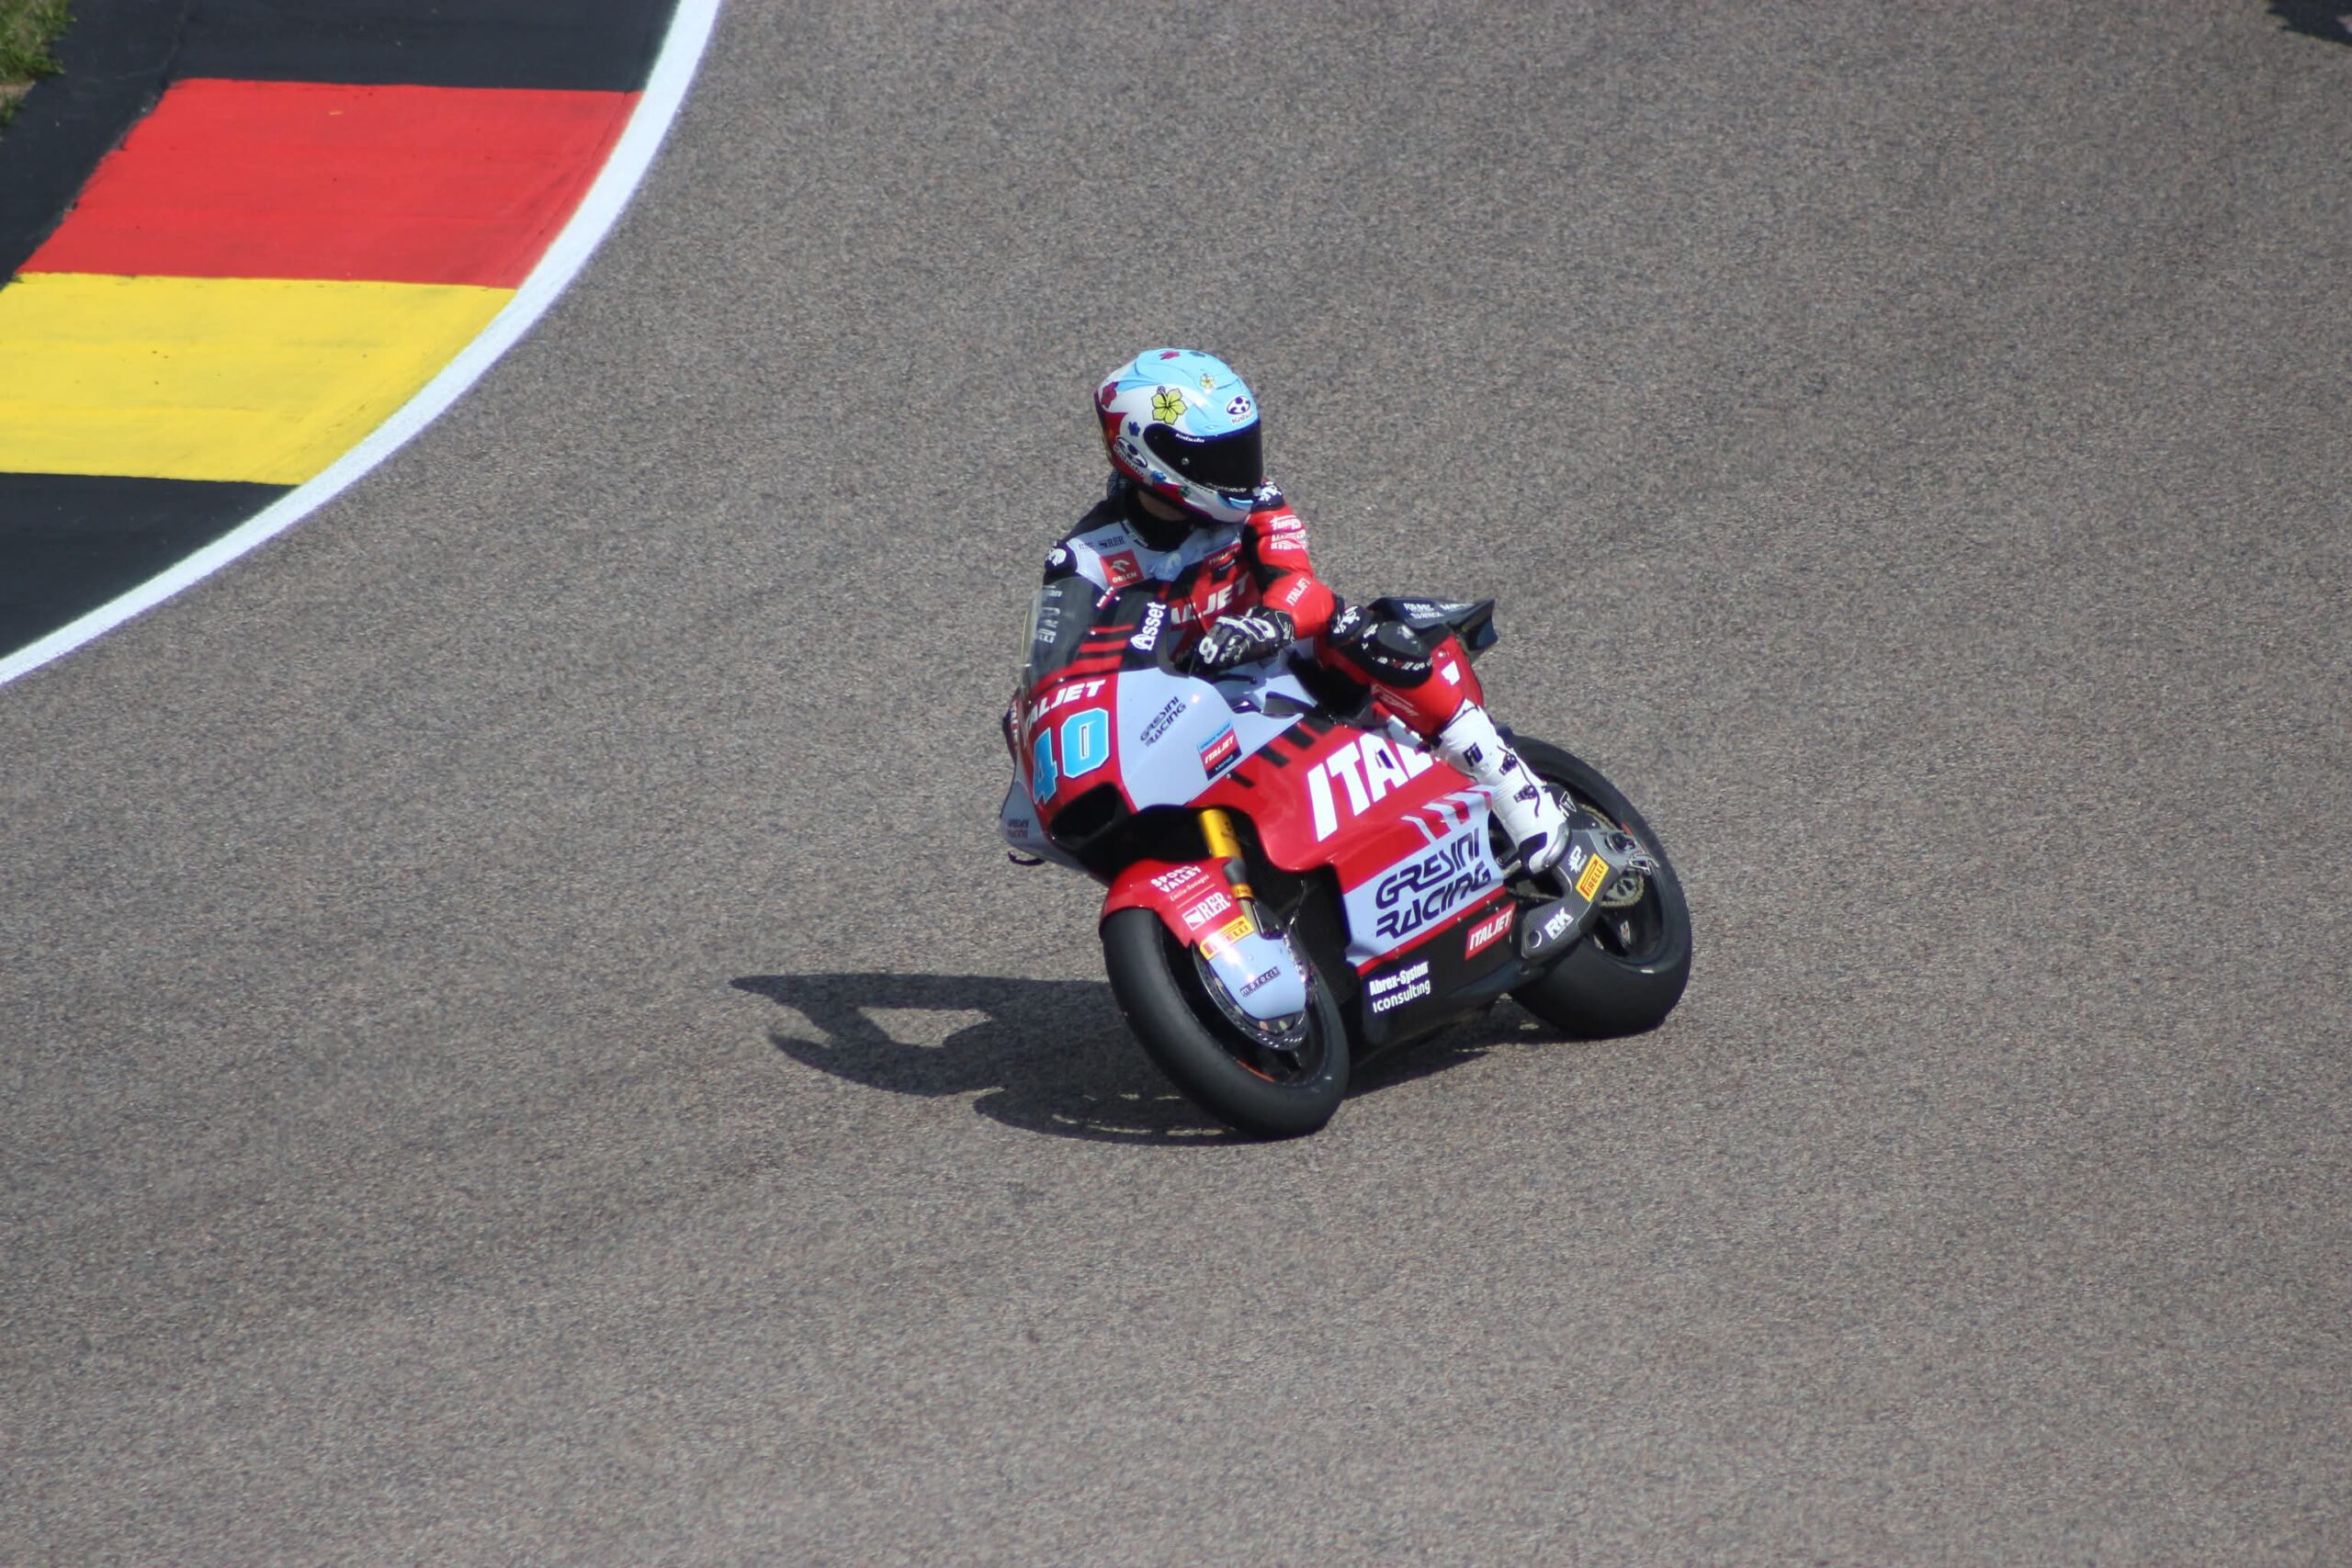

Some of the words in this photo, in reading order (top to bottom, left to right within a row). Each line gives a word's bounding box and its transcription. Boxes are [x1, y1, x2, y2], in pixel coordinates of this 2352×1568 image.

[1112, 570, 1137, 583] ORLEN
[1285, 577, 1311, 607] ITALJET
[1130, 602, 1167, 651] Asset
[1139, 695, 1180, 742] GRESINI
[1032, 706, 1110, 806] 40
[1204, 734, 1235, 764] ITALJET
[1306, 732, 1442, 842] ITAL
[1159, 865, 1202, 893] VALLEY
[1375, 827, 1480, 909] GRESINI
[1579, 858, 1606, 897] PIRELLI
[1198, 892, 1231, 921] RER
[1375, 860, 1492, 940] RACING
[1469, 909, 1513, 951] ITALJET
[1544, 907, 1574, 941] RK
[1369, 961, 1430, 997] Abrex-System
